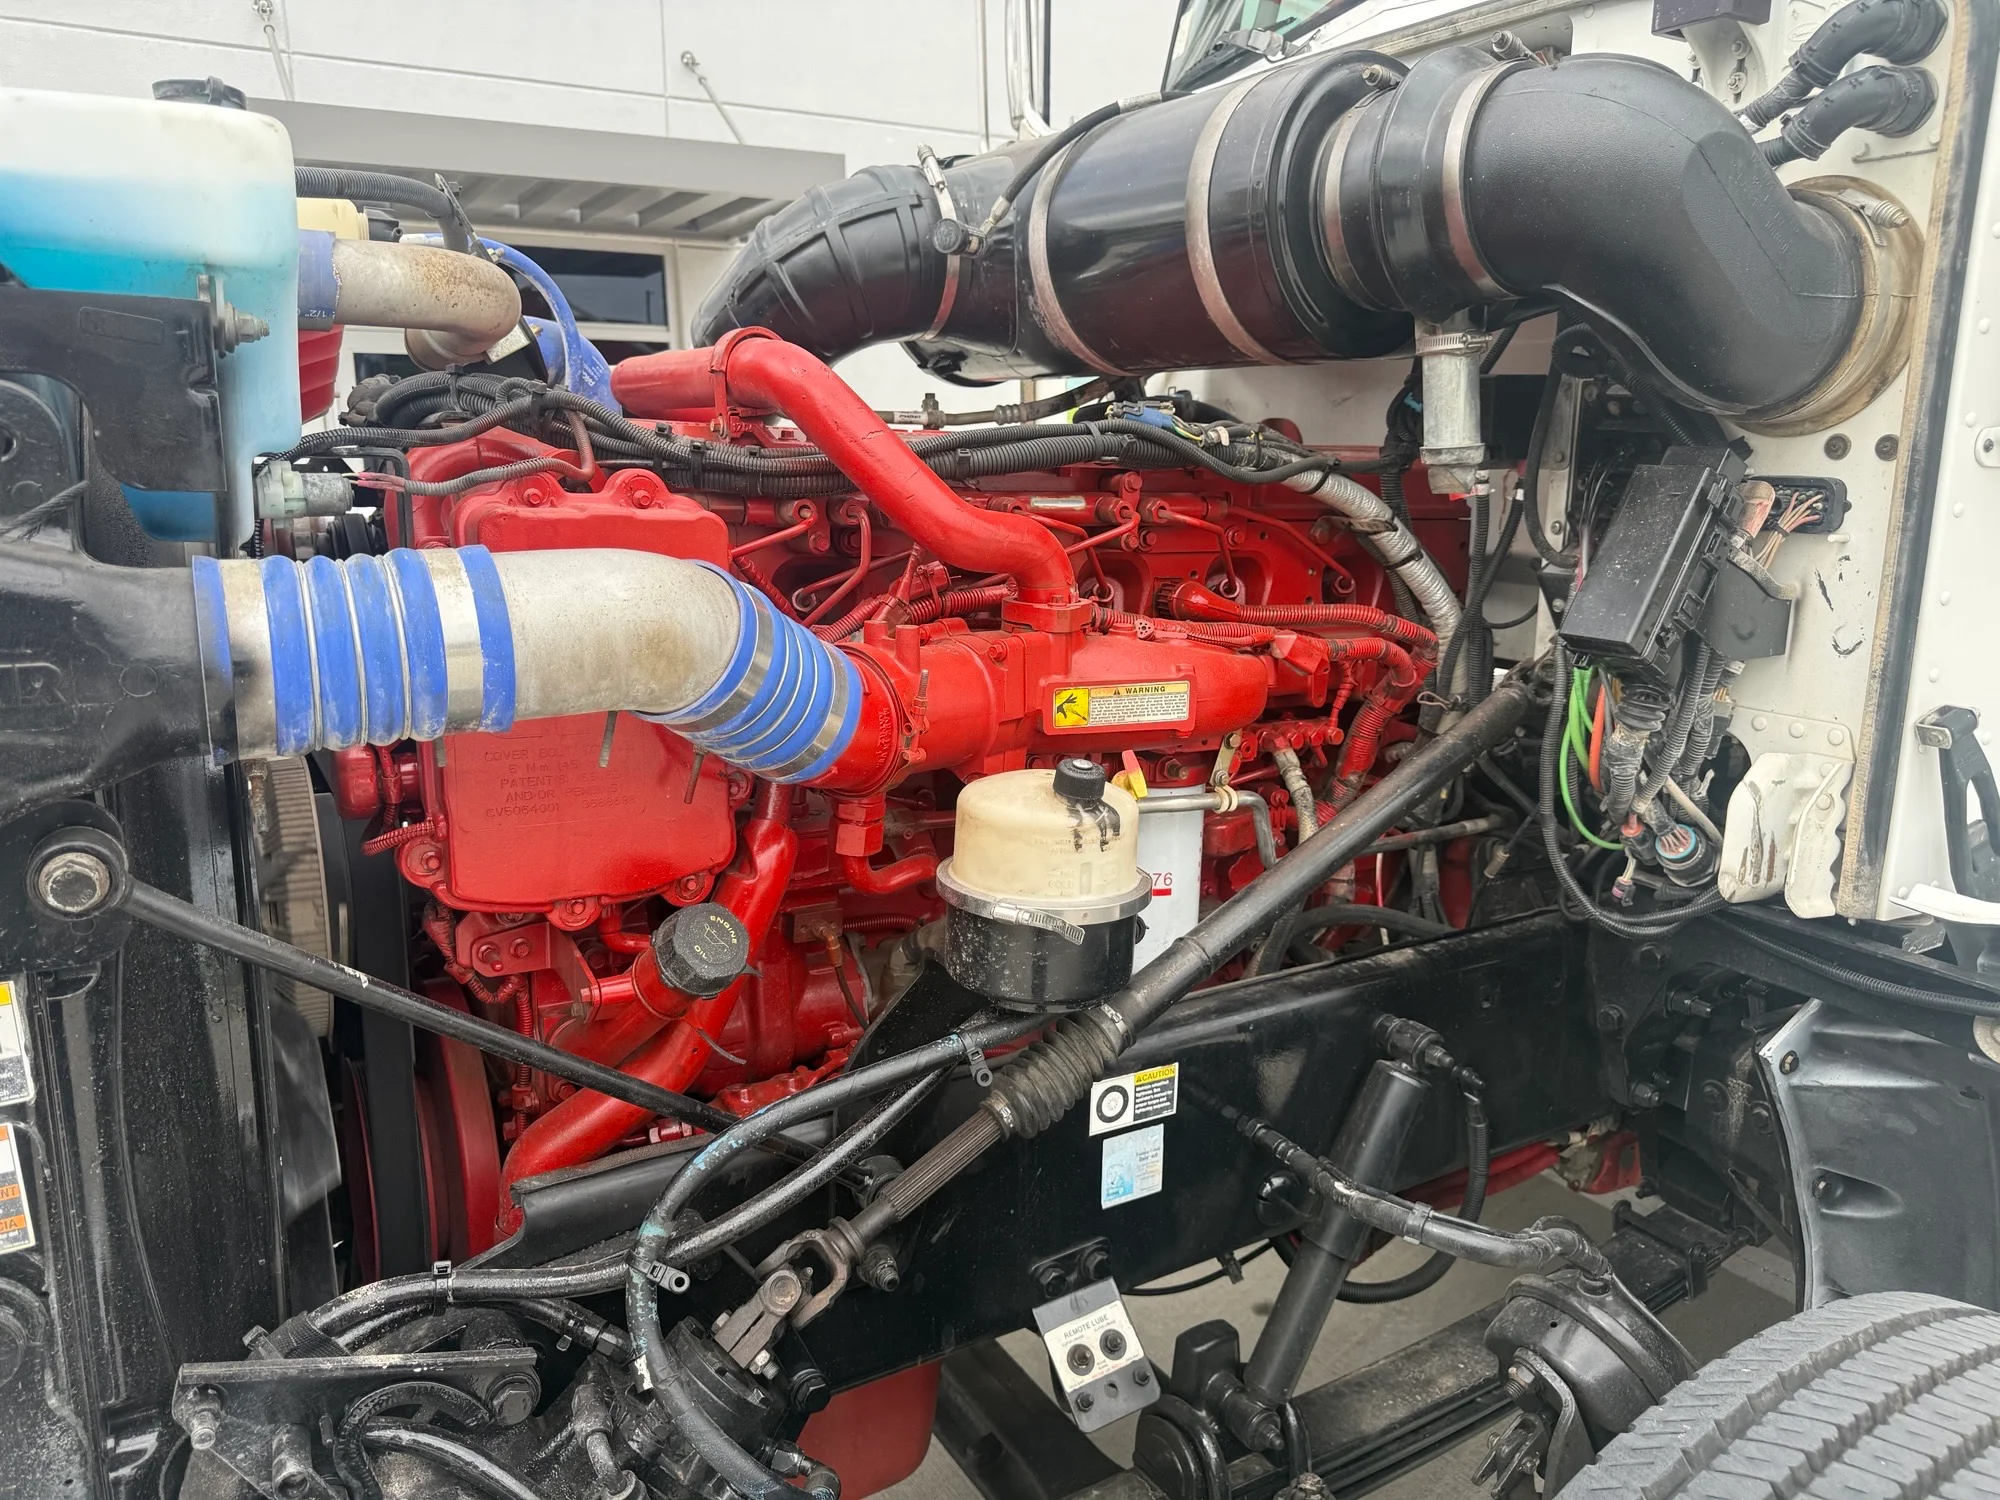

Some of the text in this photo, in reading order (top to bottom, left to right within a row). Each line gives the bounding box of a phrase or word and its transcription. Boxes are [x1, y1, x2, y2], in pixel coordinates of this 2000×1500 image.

[1125, 686, 1166, 694] WARNING
[1150, 872, 1173, 887] 76
[710, 915, 738, 944] ENGINE
[694, 944, 707, 959] OIL
[1142, 1068, 1175, 1082] CAUTION
[1063, 1323, 1092, 1339] REMOTE
[1092, 1313, 1109, 1327] LUBE
